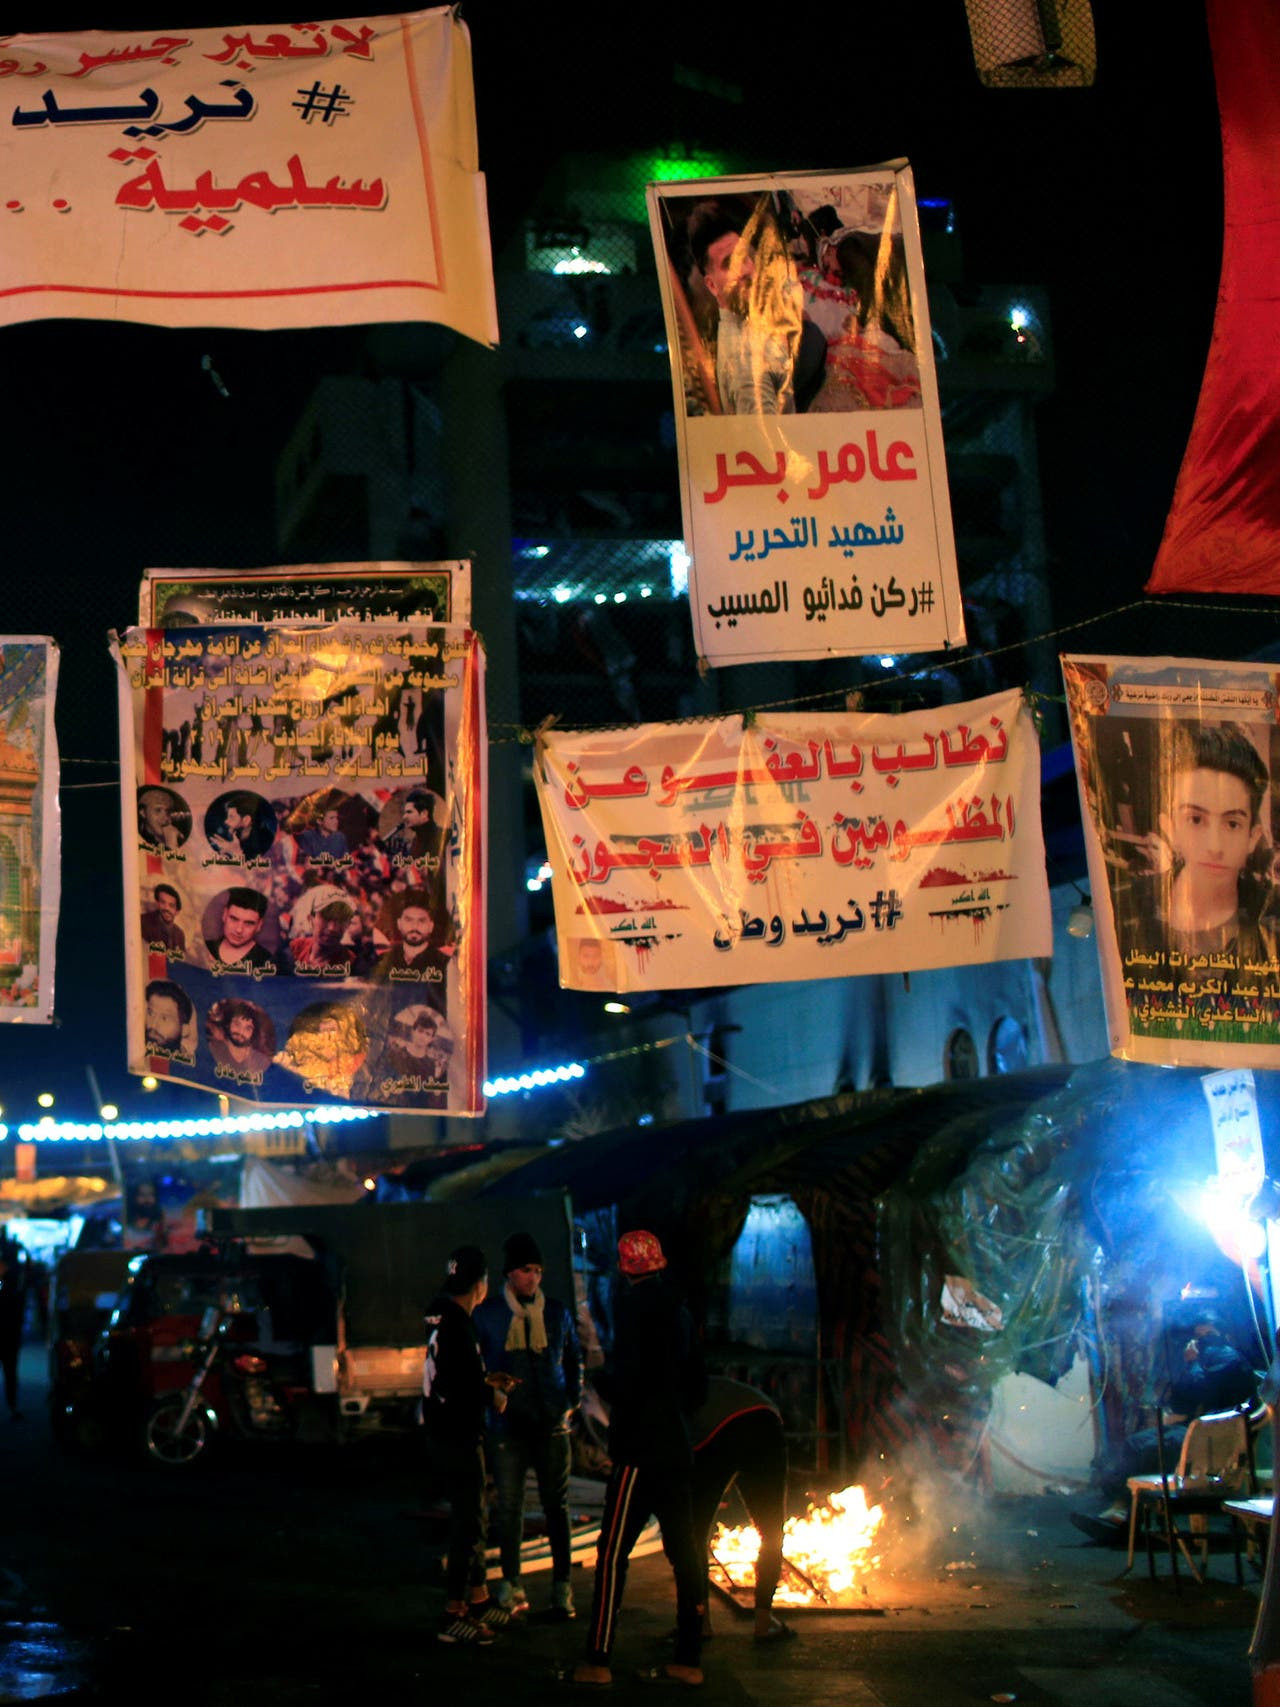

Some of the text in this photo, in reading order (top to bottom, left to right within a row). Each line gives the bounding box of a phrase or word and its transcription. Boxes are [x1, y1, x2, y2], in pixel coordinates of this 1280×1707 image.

[71, 30, 192, 78] جسر
[12, 79, 255, 141] نريد
[114, 146, 389, 235] سلمية
[704, 430, 918, 505] عامر بحر
[729, 506, 904, 562] شهيد التحرير
[707, 580, 788, 630] المسيب
[802, 574, 864, 622] فدائيو
[243, 640, 262, 661] عن
[384, 670, 404, 690] من
[407, 671, 459, 692] مجموعة
[200, 695, 244, 722] العراق
[375, 730, 401, 753] يوم
[160, 752, 228, 780] الجمهورية
[228, 761, 261, 782] جسر
[386, 755, 429, 777] الساعة
[564, 715, 1011, 810] نطالب بالعفو عن
[567, 794, 1016, 888] المظلومين في السجون
[713, 911, 785, 952] وطن
[791, 897, 864, 945] نريد
[1125, 948, 1166, 970] البطل
[1169, 951, 1241, 972] المظاهرات
[1137, 976, 1175, 993] محمد
[1178, 977, 1228, 999] الكريم
[1231, 982, 1260, 1000] عبد
[1199, 1005, 1266, 1027] الساعدي
